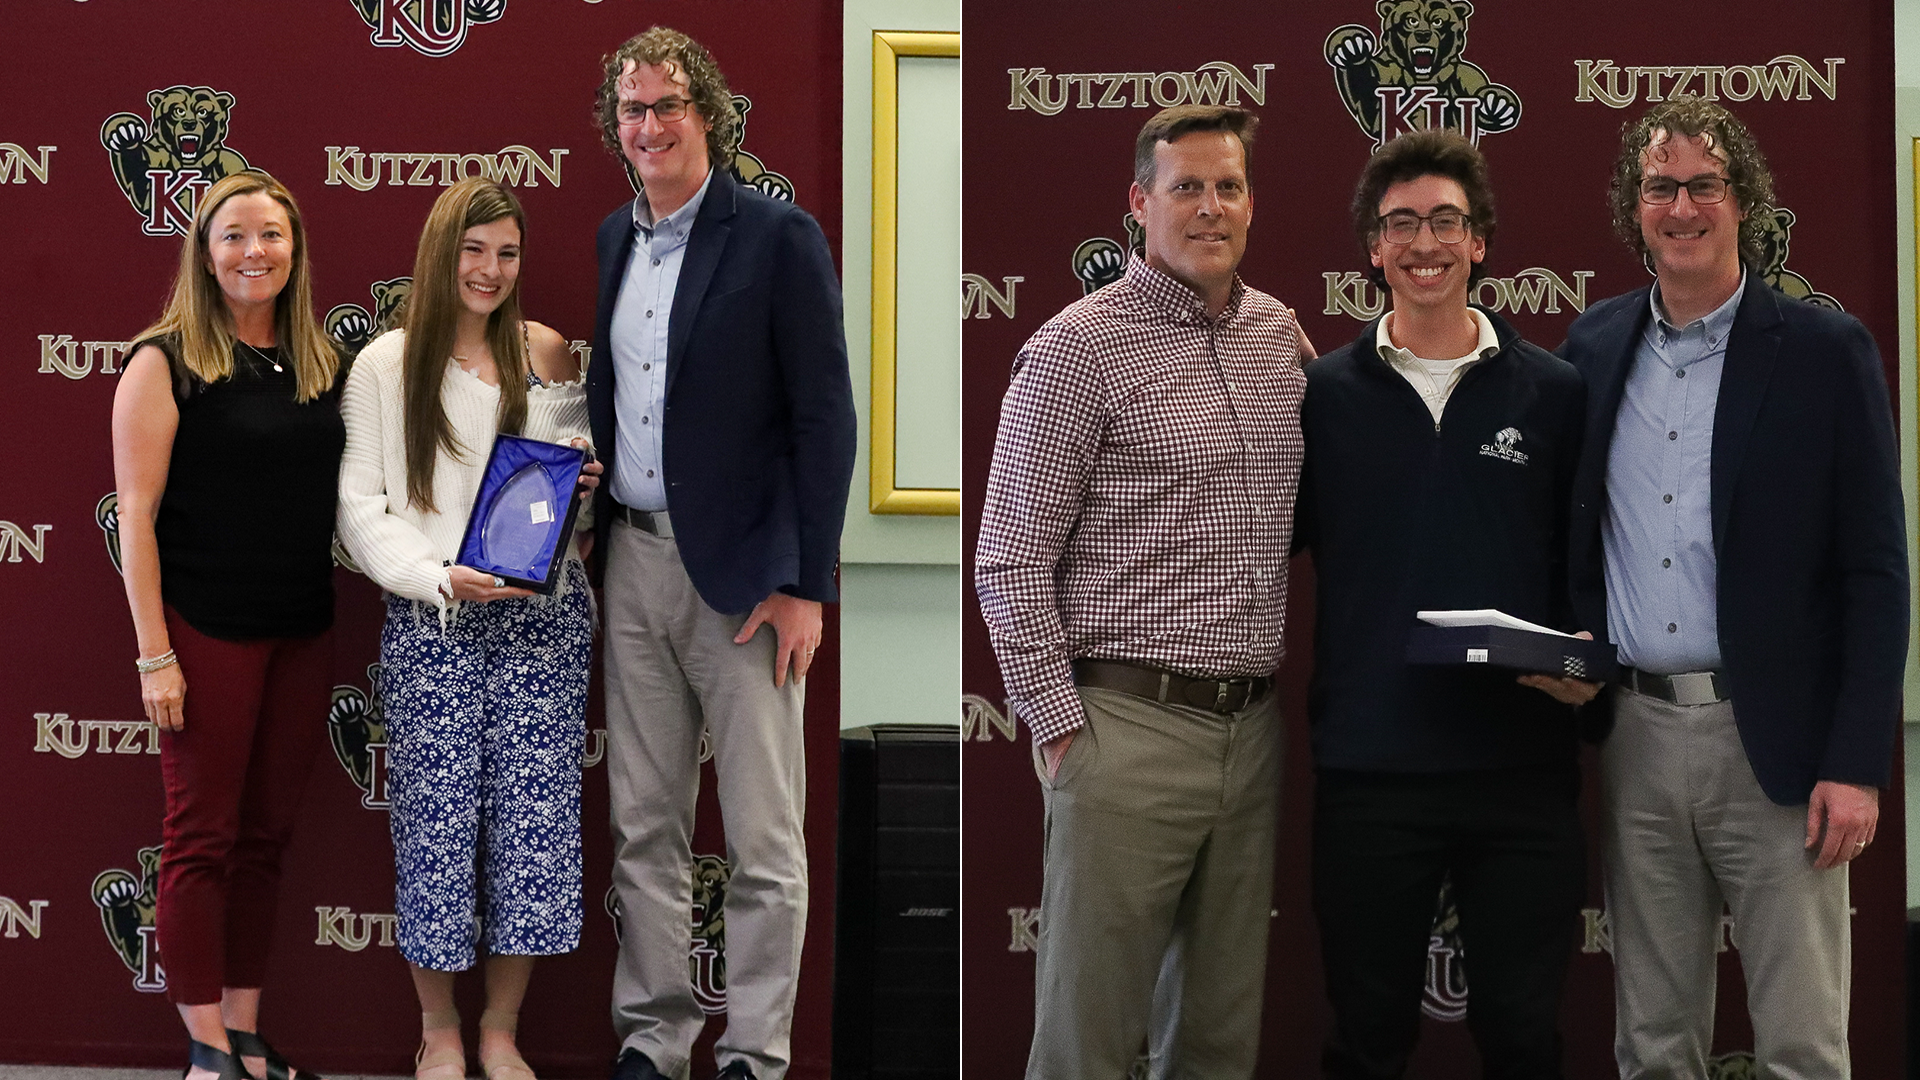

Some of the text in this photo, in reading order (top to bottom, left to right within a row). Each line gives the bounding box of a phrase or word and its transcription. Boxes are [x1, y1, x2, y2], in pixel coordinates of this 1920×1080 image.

[371, 0, 468, 57] KU
[1007, 61, 1275, 116] KUTZTOWN
[1574, 54, 1845, 109] KUTZTOWN
[1375, 86, 1482, 151] KU
[325, 144, 569, 192] KUTZTOWN
[38, 334, 129, 380] KUT
[1480, 444, 1529, 461] GLACIER
[0, 895, 49, 939] N
[899, 907, 953, 917] BOSE
